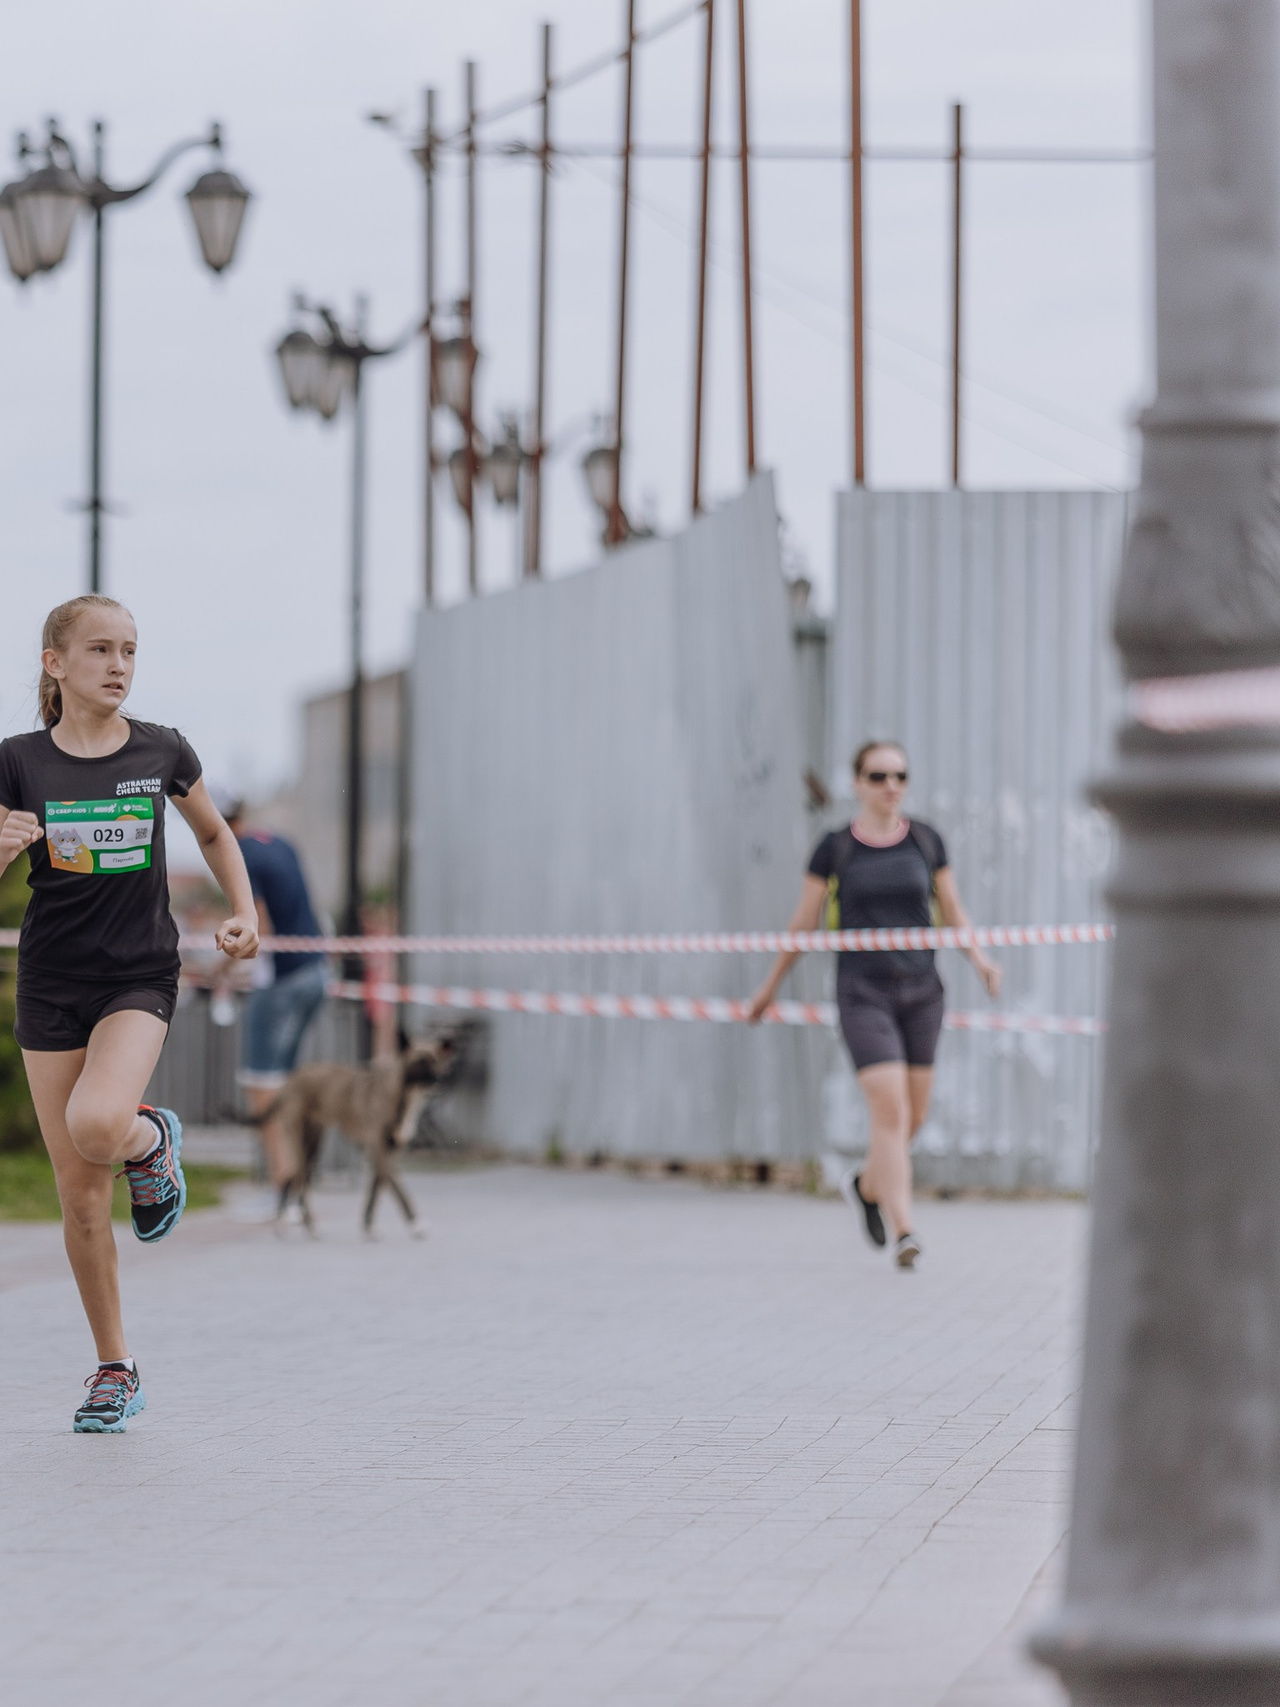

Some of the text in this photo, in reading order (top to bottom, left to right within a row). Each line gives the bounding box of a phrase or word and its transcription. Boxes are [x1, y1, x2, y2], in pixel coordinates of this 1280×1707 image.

[116, 779, 162, 790] ASTRAKHAN
[115, 785, 161, 796] CHEER TEAM
[93, 828, 124, 843] 029
